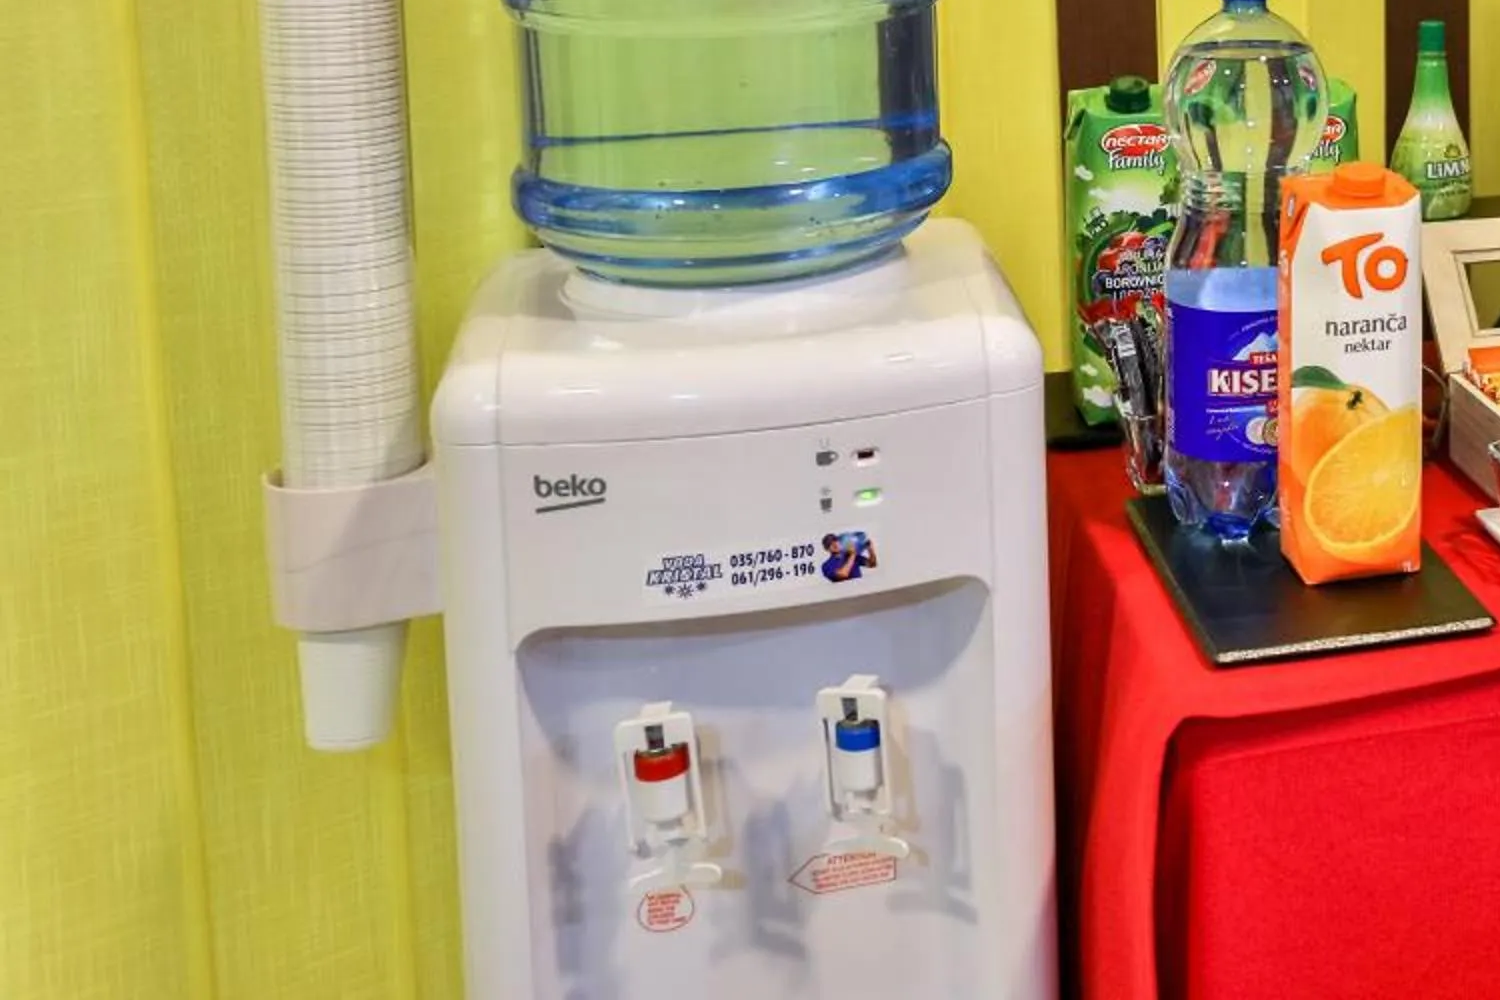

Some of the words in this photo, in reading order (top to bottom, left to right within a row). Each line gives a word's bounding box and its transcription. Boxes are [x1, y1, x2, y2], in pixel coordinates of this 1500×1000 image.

[1105, 273, 1165, 289] BOROVNIC
[1325, 313, 1408, 337] naranča
[1344, 337, 1392, 354] nektar
[1208, 368, 1278, 396] KISE
[533, 473, 608, 500] beko
